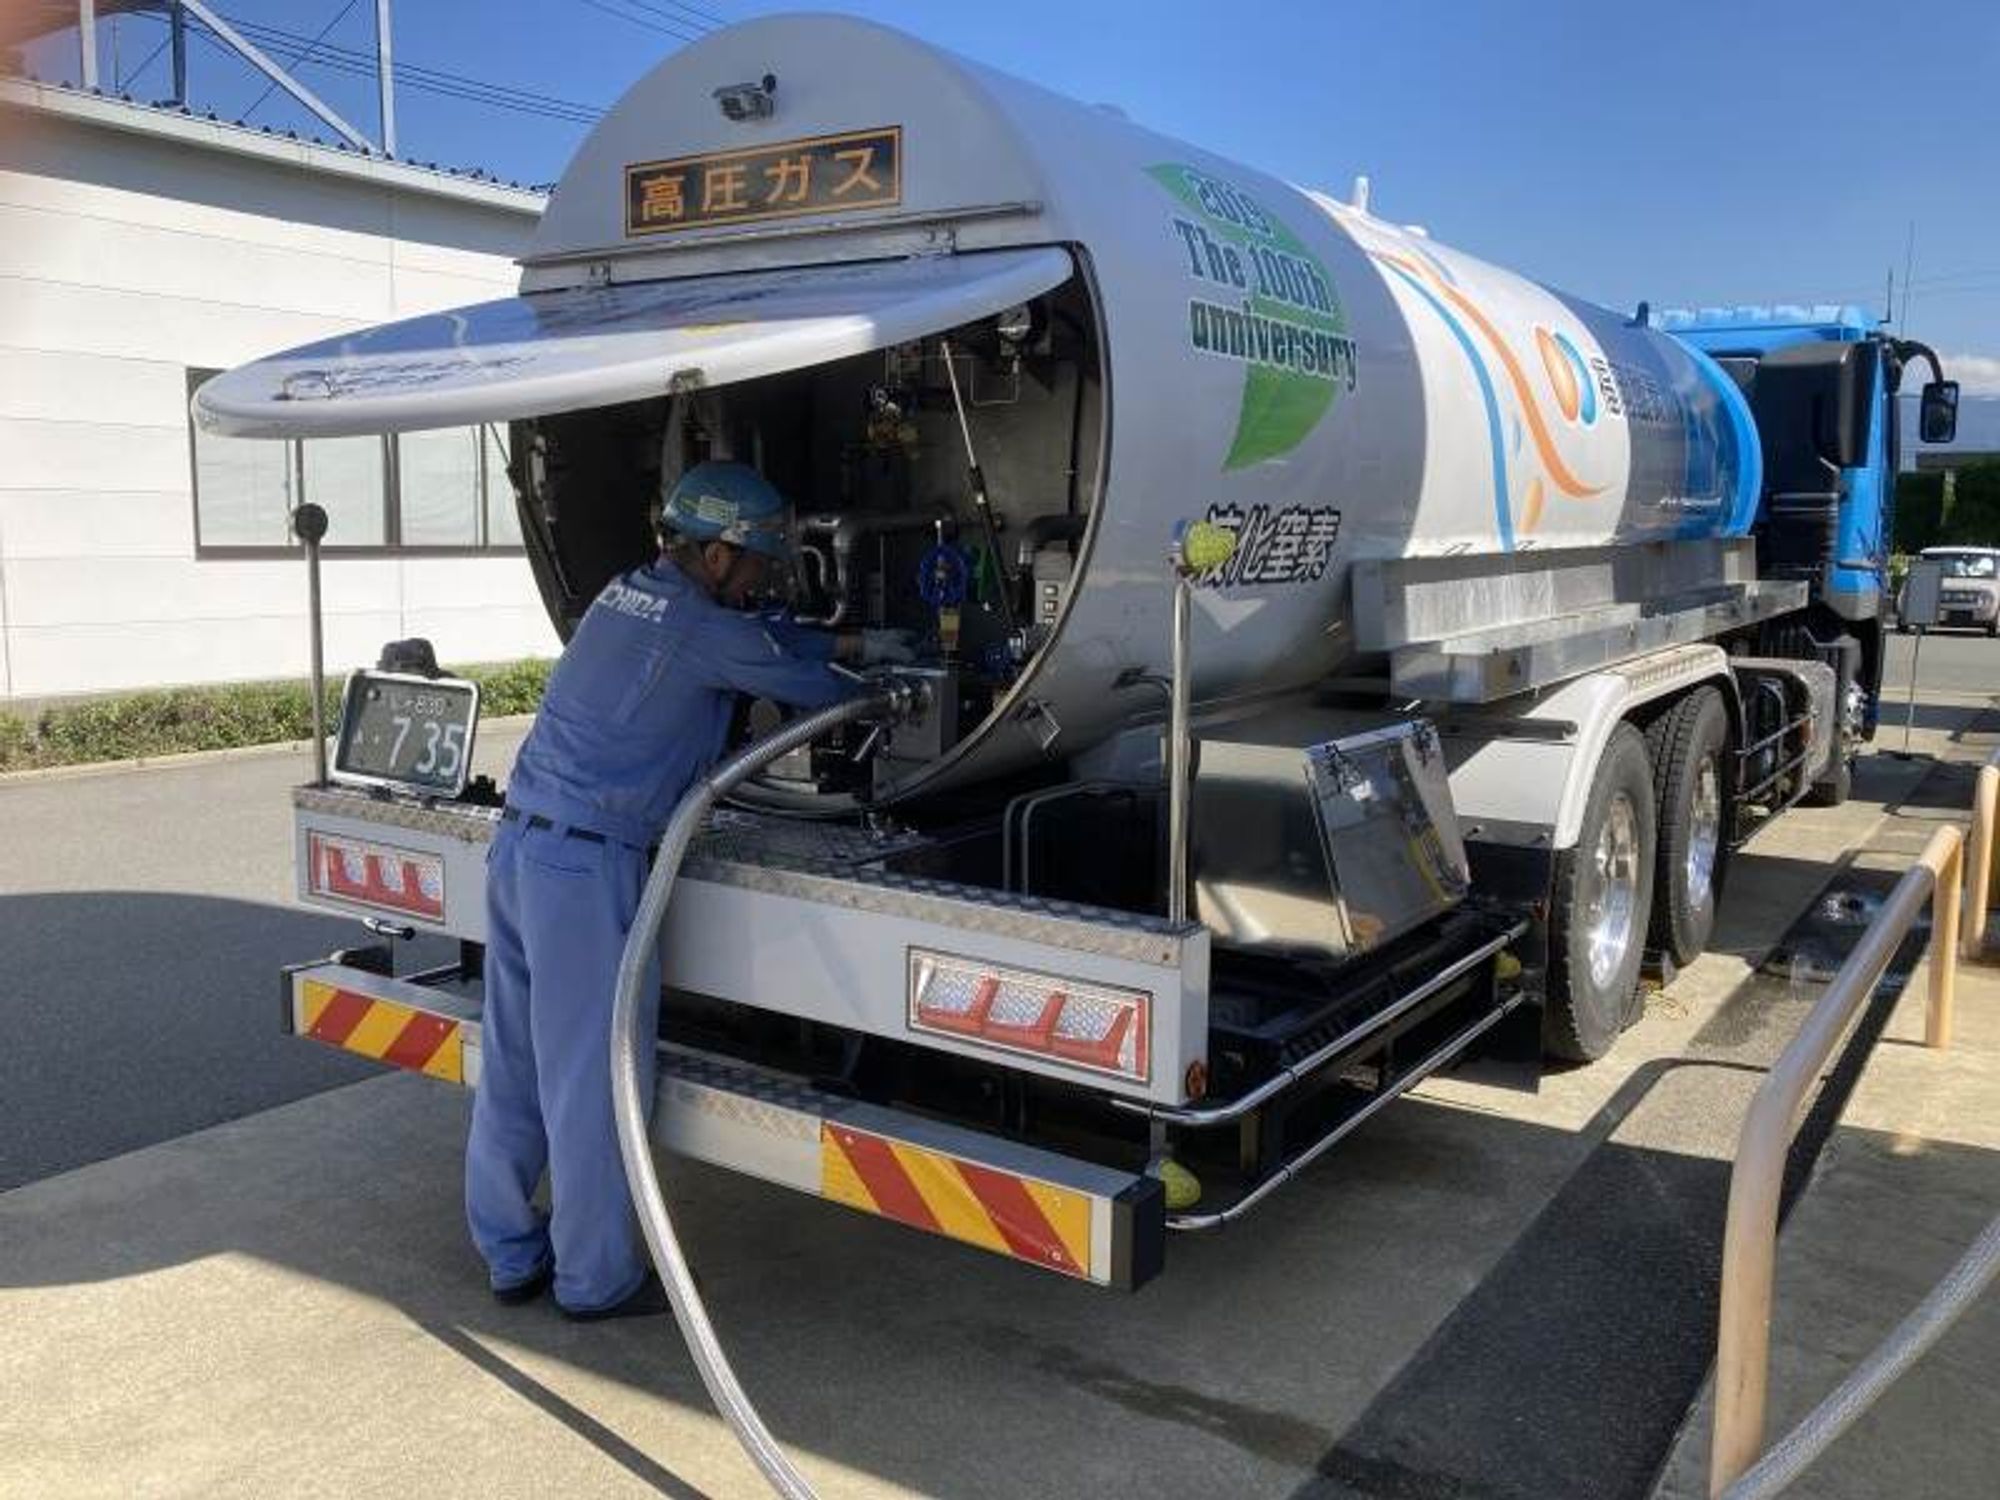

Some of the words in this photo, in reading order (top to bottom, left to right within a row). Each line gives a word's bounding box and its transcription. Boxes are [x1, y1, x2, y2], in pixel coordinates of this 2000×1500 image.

[640, 146, 881, 222] 高圧ガス
[1172, 216, 1248, 291] The
[1248, 244, 1334, 316] 100th
[1188, 298, 1358, 394] anniversary
